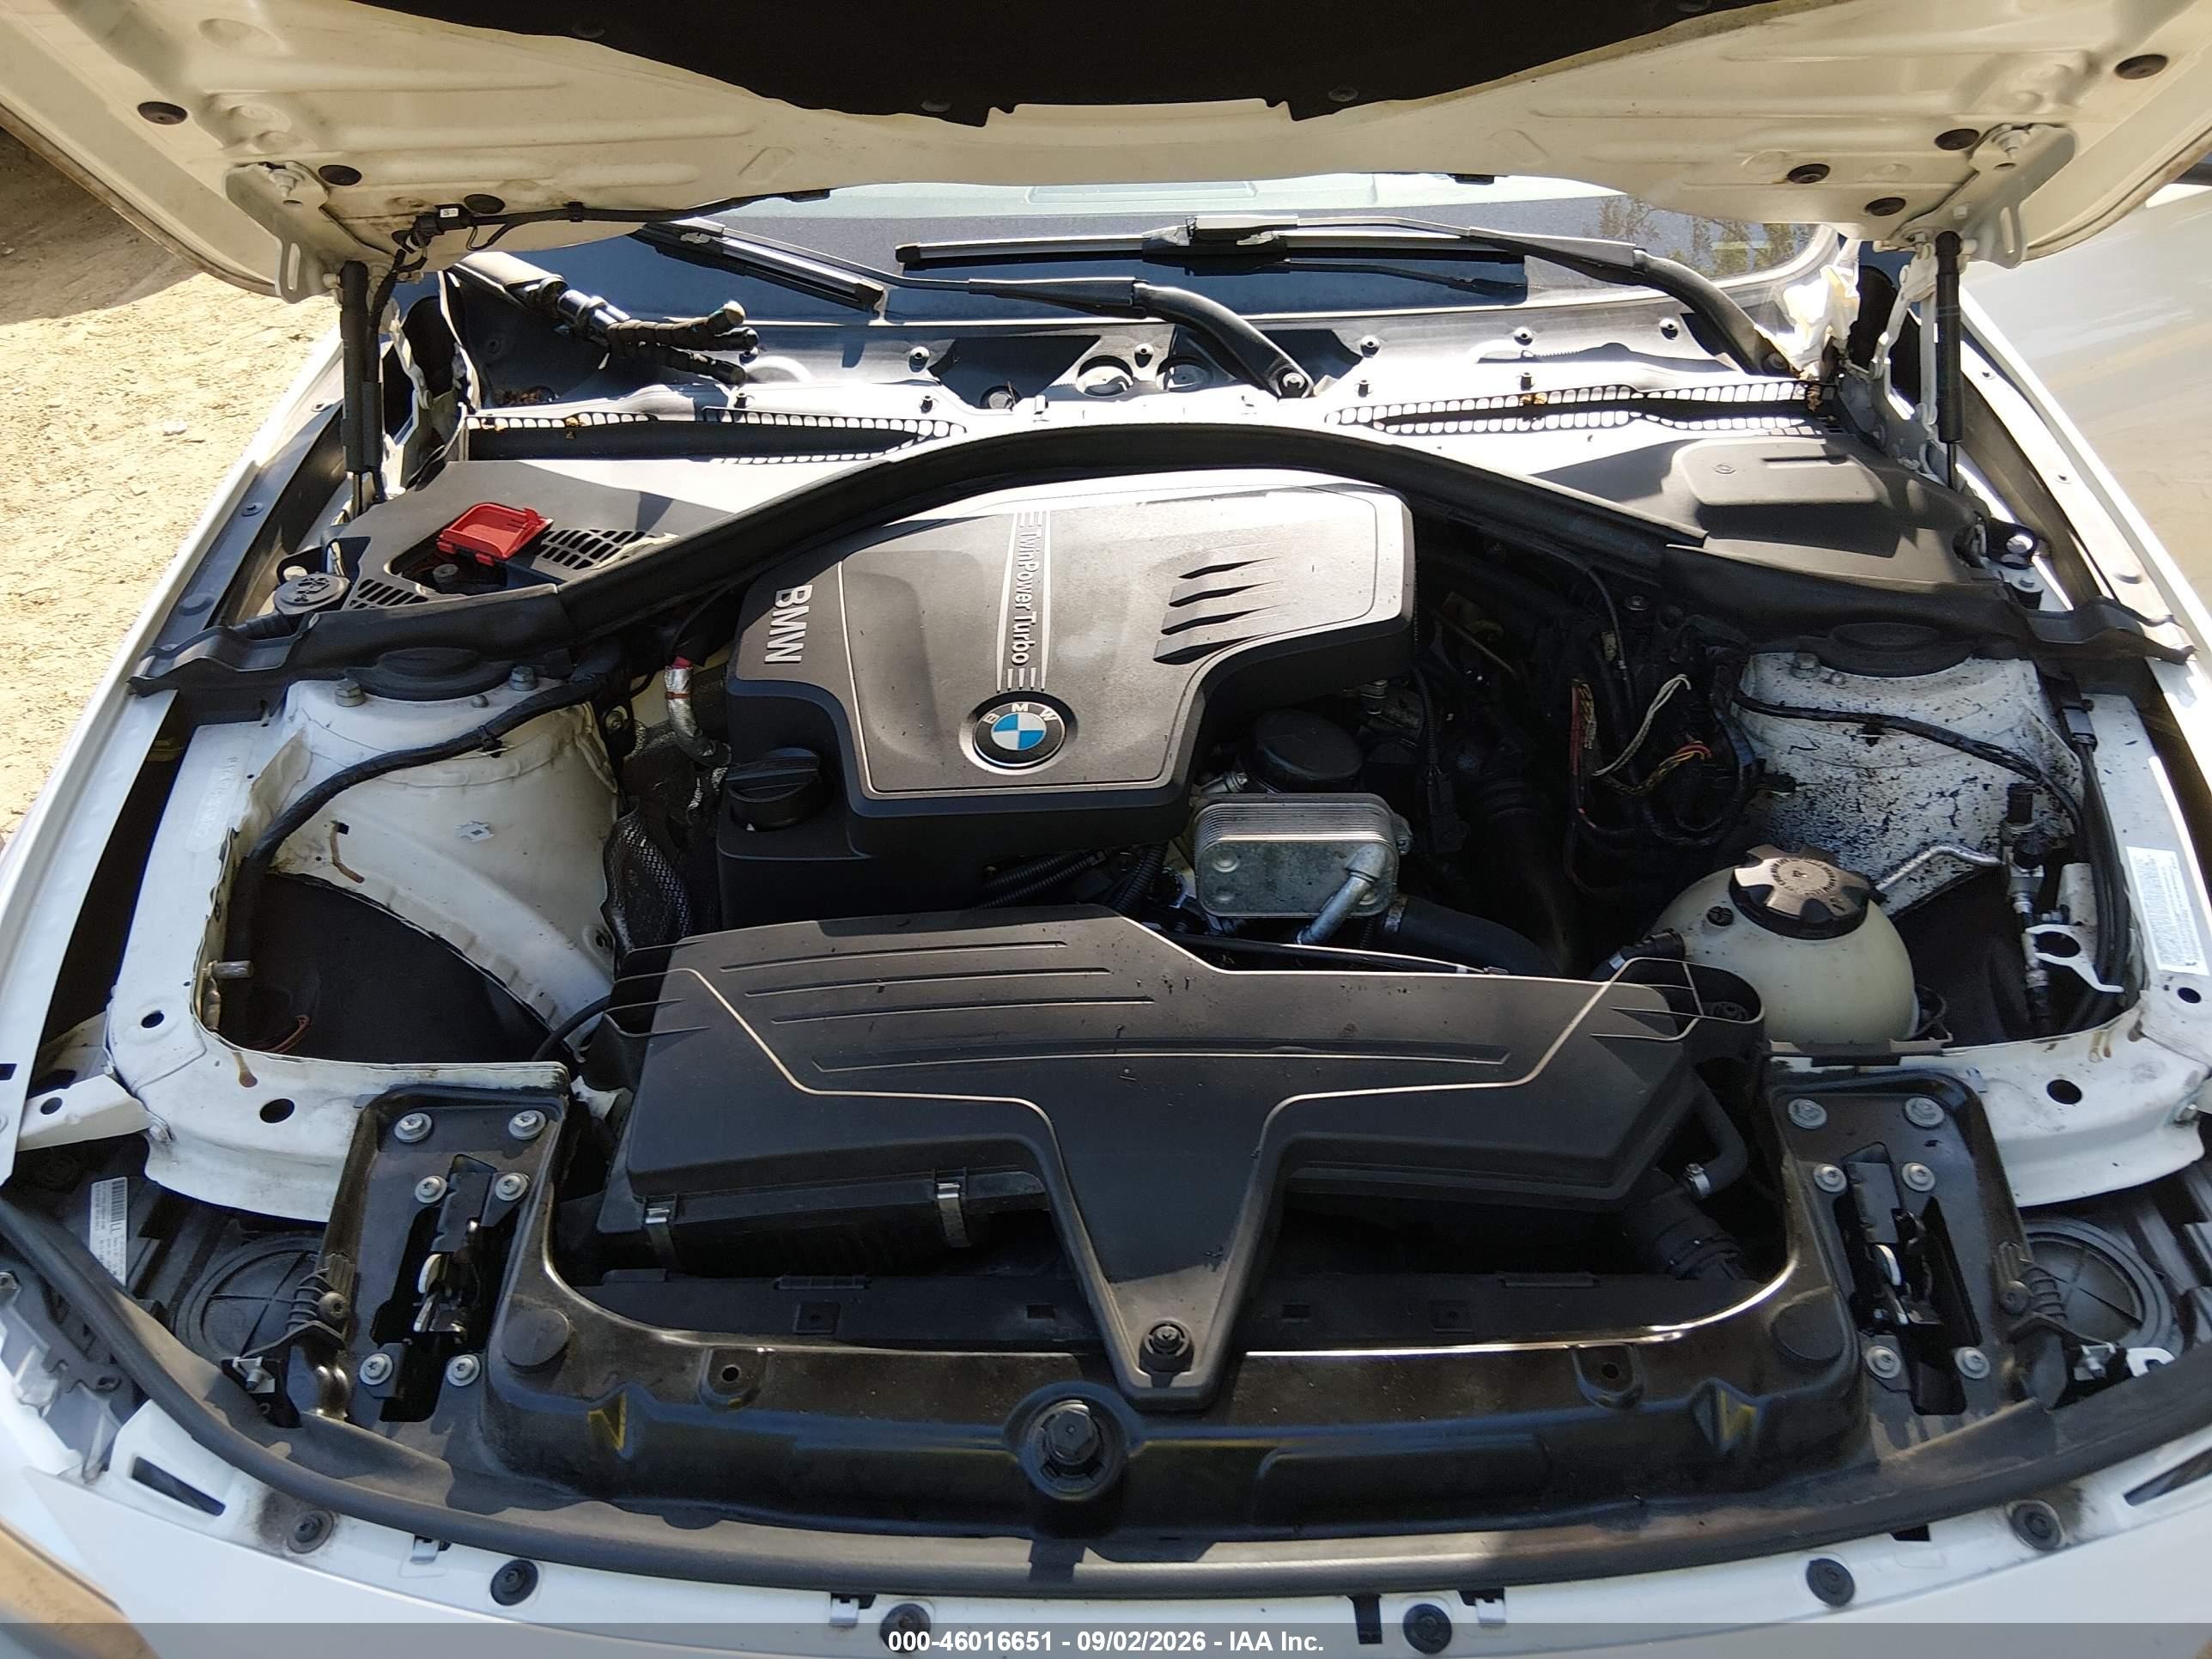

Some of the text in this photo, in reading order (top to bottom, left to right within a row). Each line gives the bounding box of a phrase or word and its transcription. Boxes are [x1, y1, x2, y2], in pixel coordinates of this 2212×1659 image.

[764, 584, 813, 664] BMW
[1011, 611, 1037, 665] Turbo
[982, 703, 1059, 725] BMW
